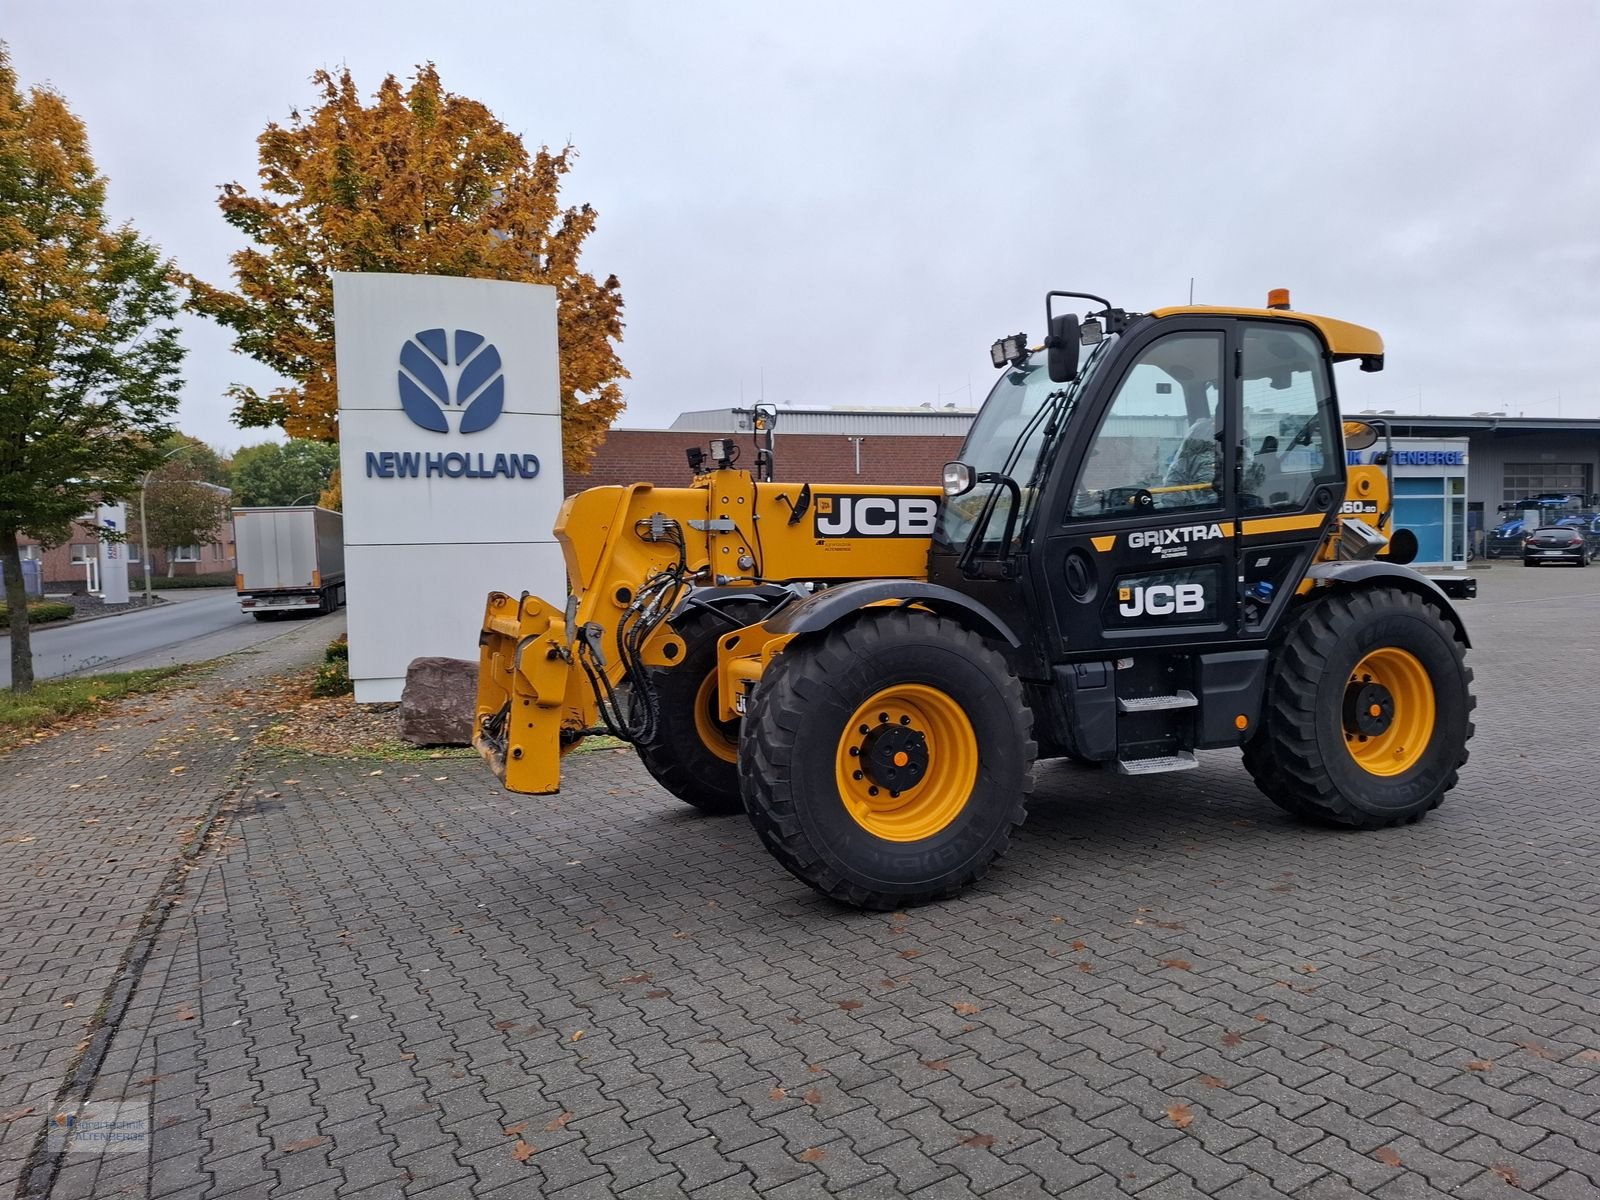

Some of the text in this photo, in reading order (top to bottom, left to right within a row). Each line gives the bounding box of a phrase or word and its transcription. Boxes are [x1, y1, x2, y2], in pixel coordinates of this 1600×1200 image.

[366, 452, 540, 479] NEW HOLLAND
[817, 498, 937, 535] JCB
[1338, 501, 1377, 513] 60-80
[1128, 523, 1223, 548] GRIXTRA
[1119, 583, 1205, 617] JCB
